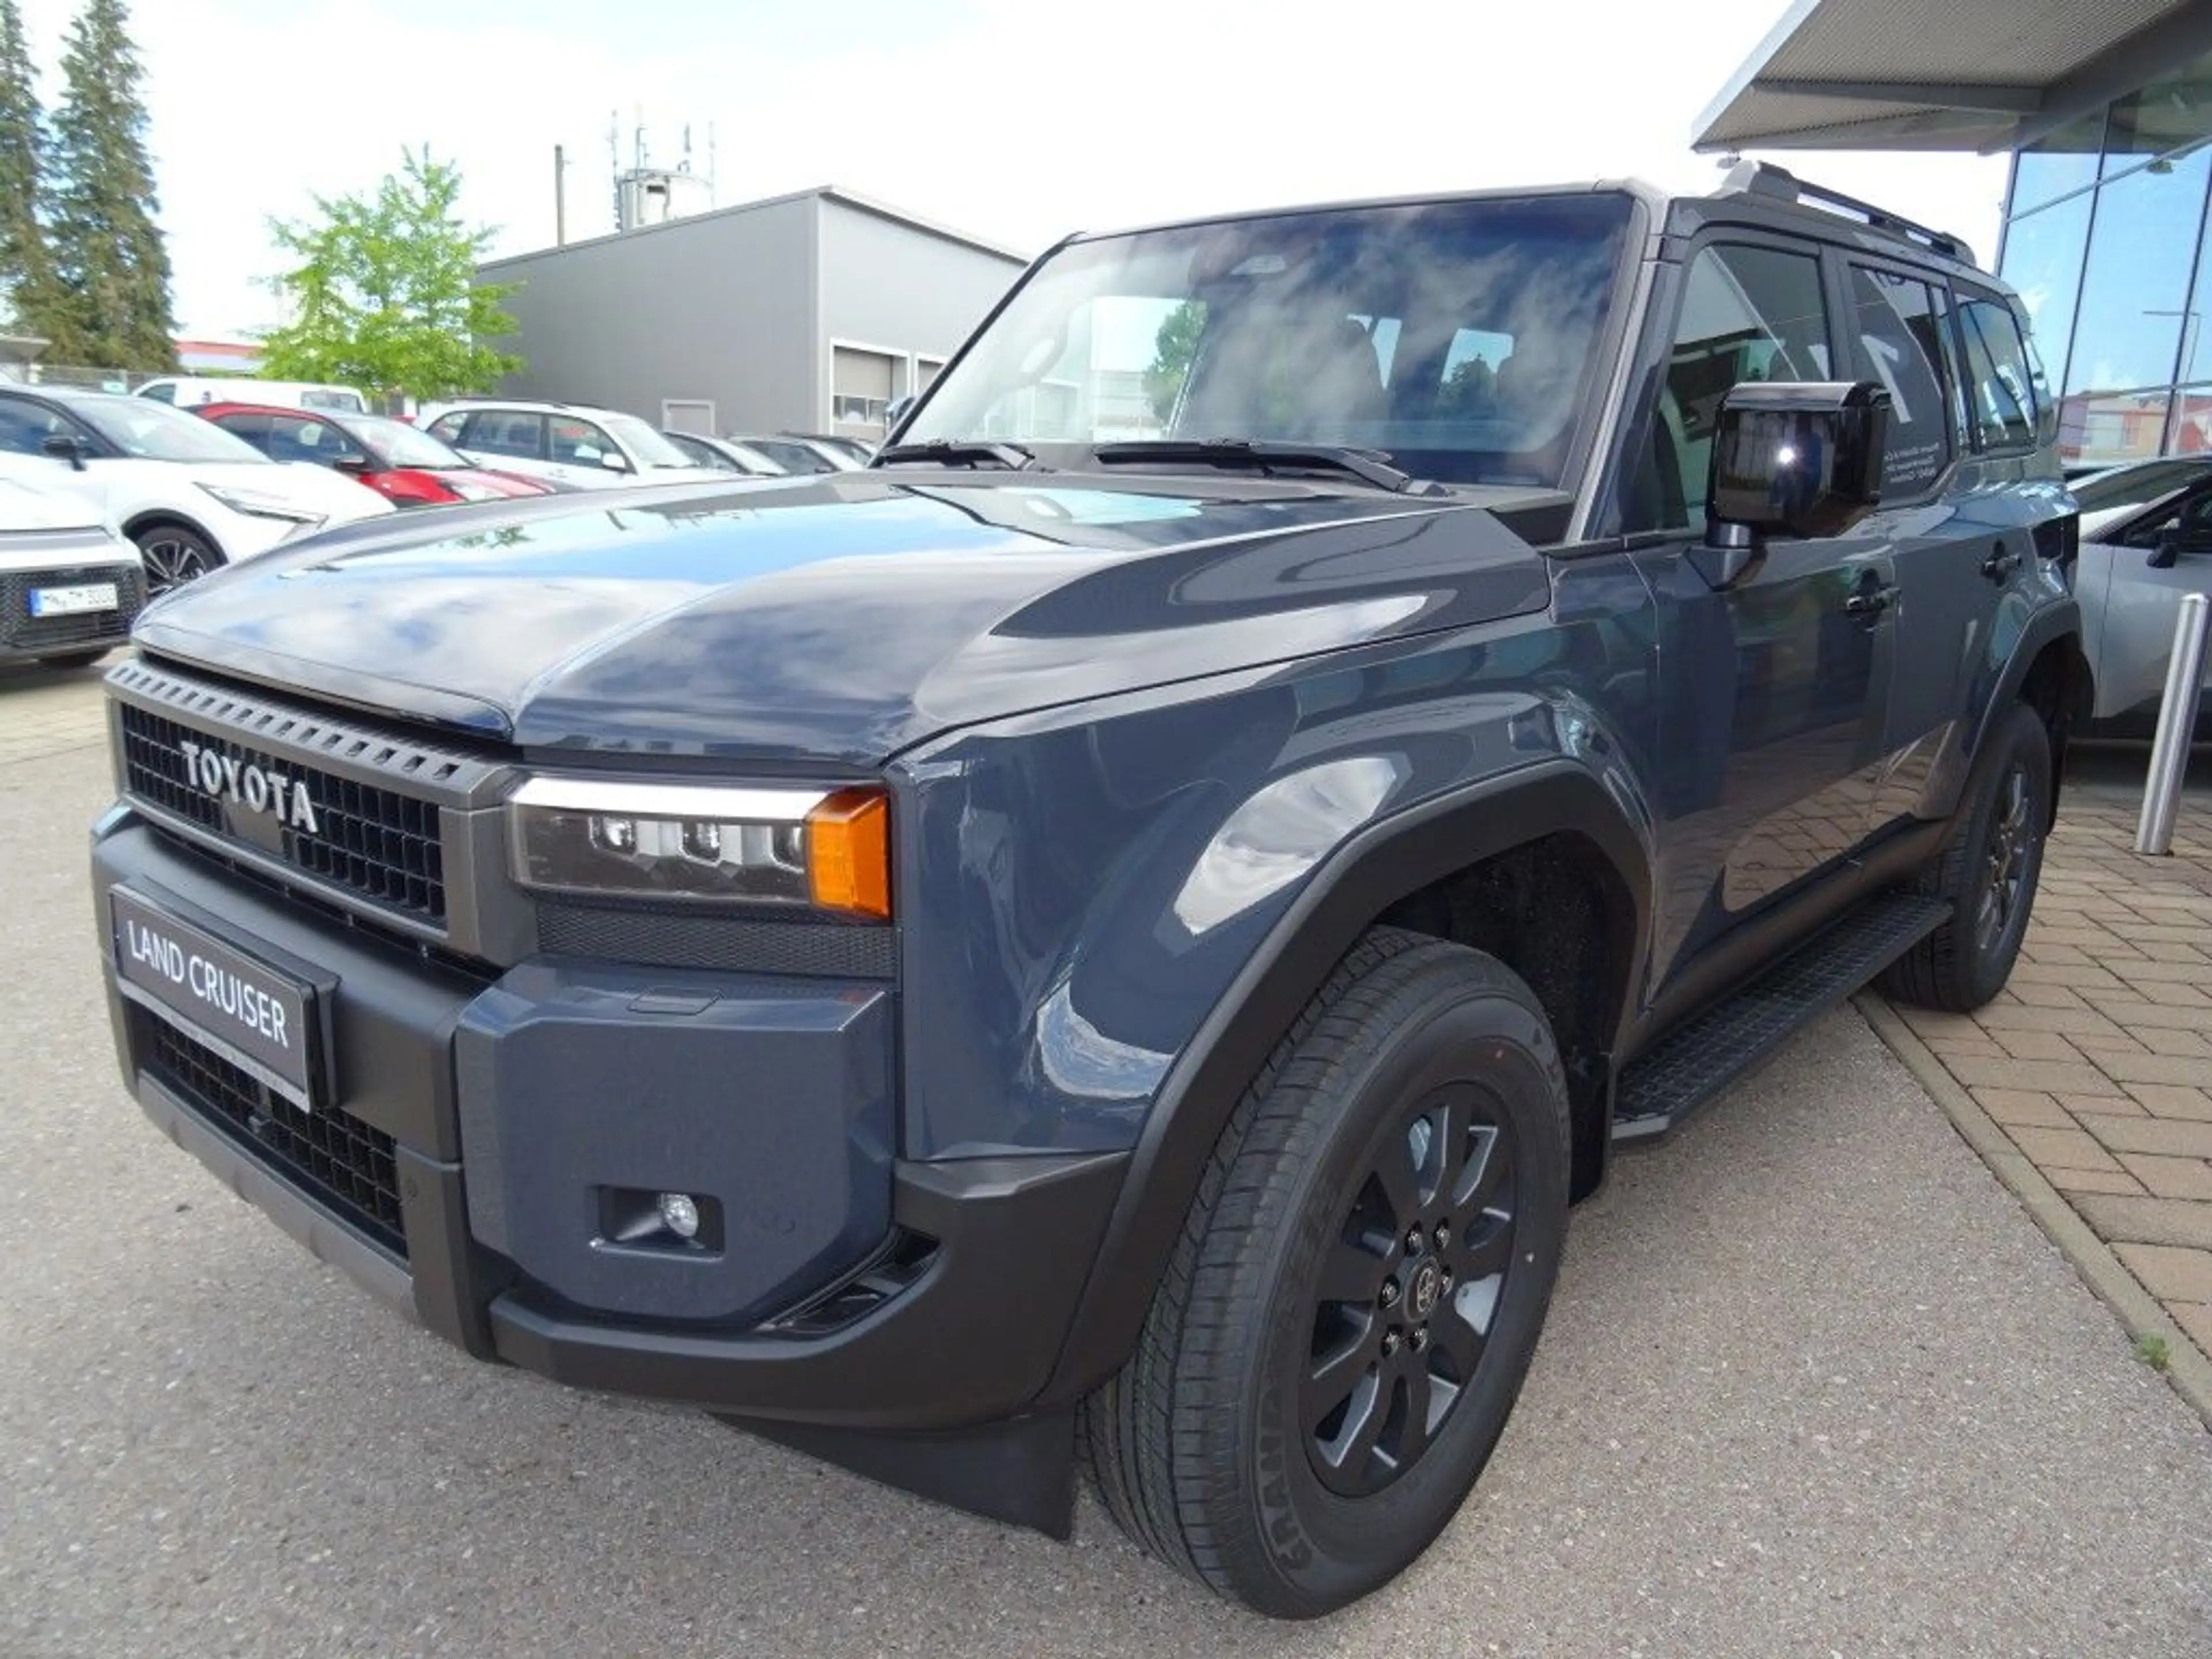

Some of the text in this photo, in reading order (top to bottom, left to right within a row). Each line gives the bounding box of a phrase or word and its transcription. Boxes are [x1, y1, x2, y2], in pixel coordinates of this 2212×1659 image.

[180, 740, 318, 833] TOYOTA
[127, 919, 289, 1048] LAND CRUISER
